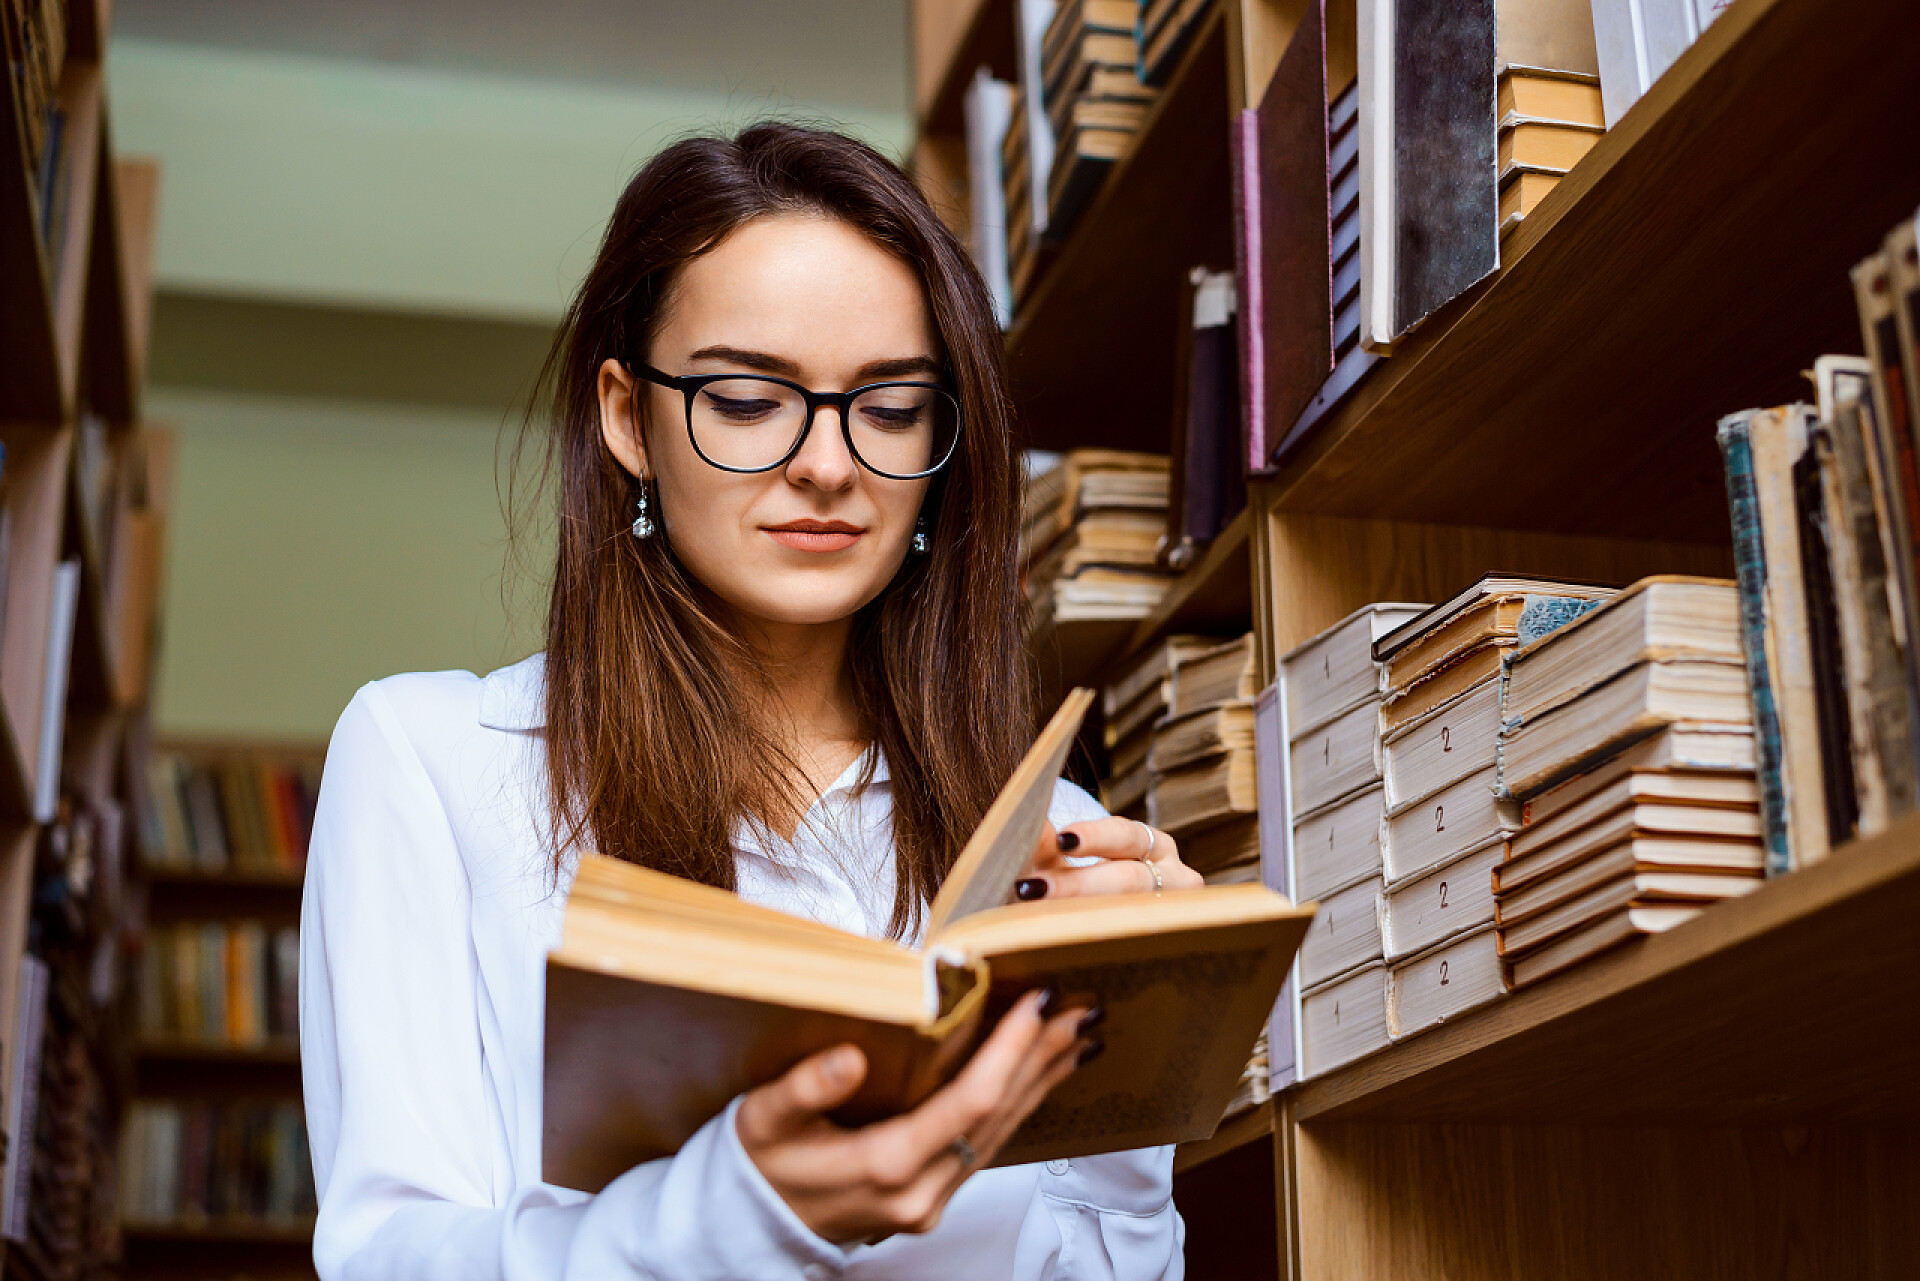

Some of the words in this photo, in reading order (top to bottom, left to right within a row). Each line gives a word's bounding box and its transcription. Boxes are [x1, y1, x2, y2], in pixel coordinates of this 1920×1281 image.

[1441, 725, 1453, 753] 2
[1435, 805, 1445, 833] 2
[1439, 881, 1449, 910] 2
[1439, 960, 1450, 987] 2
